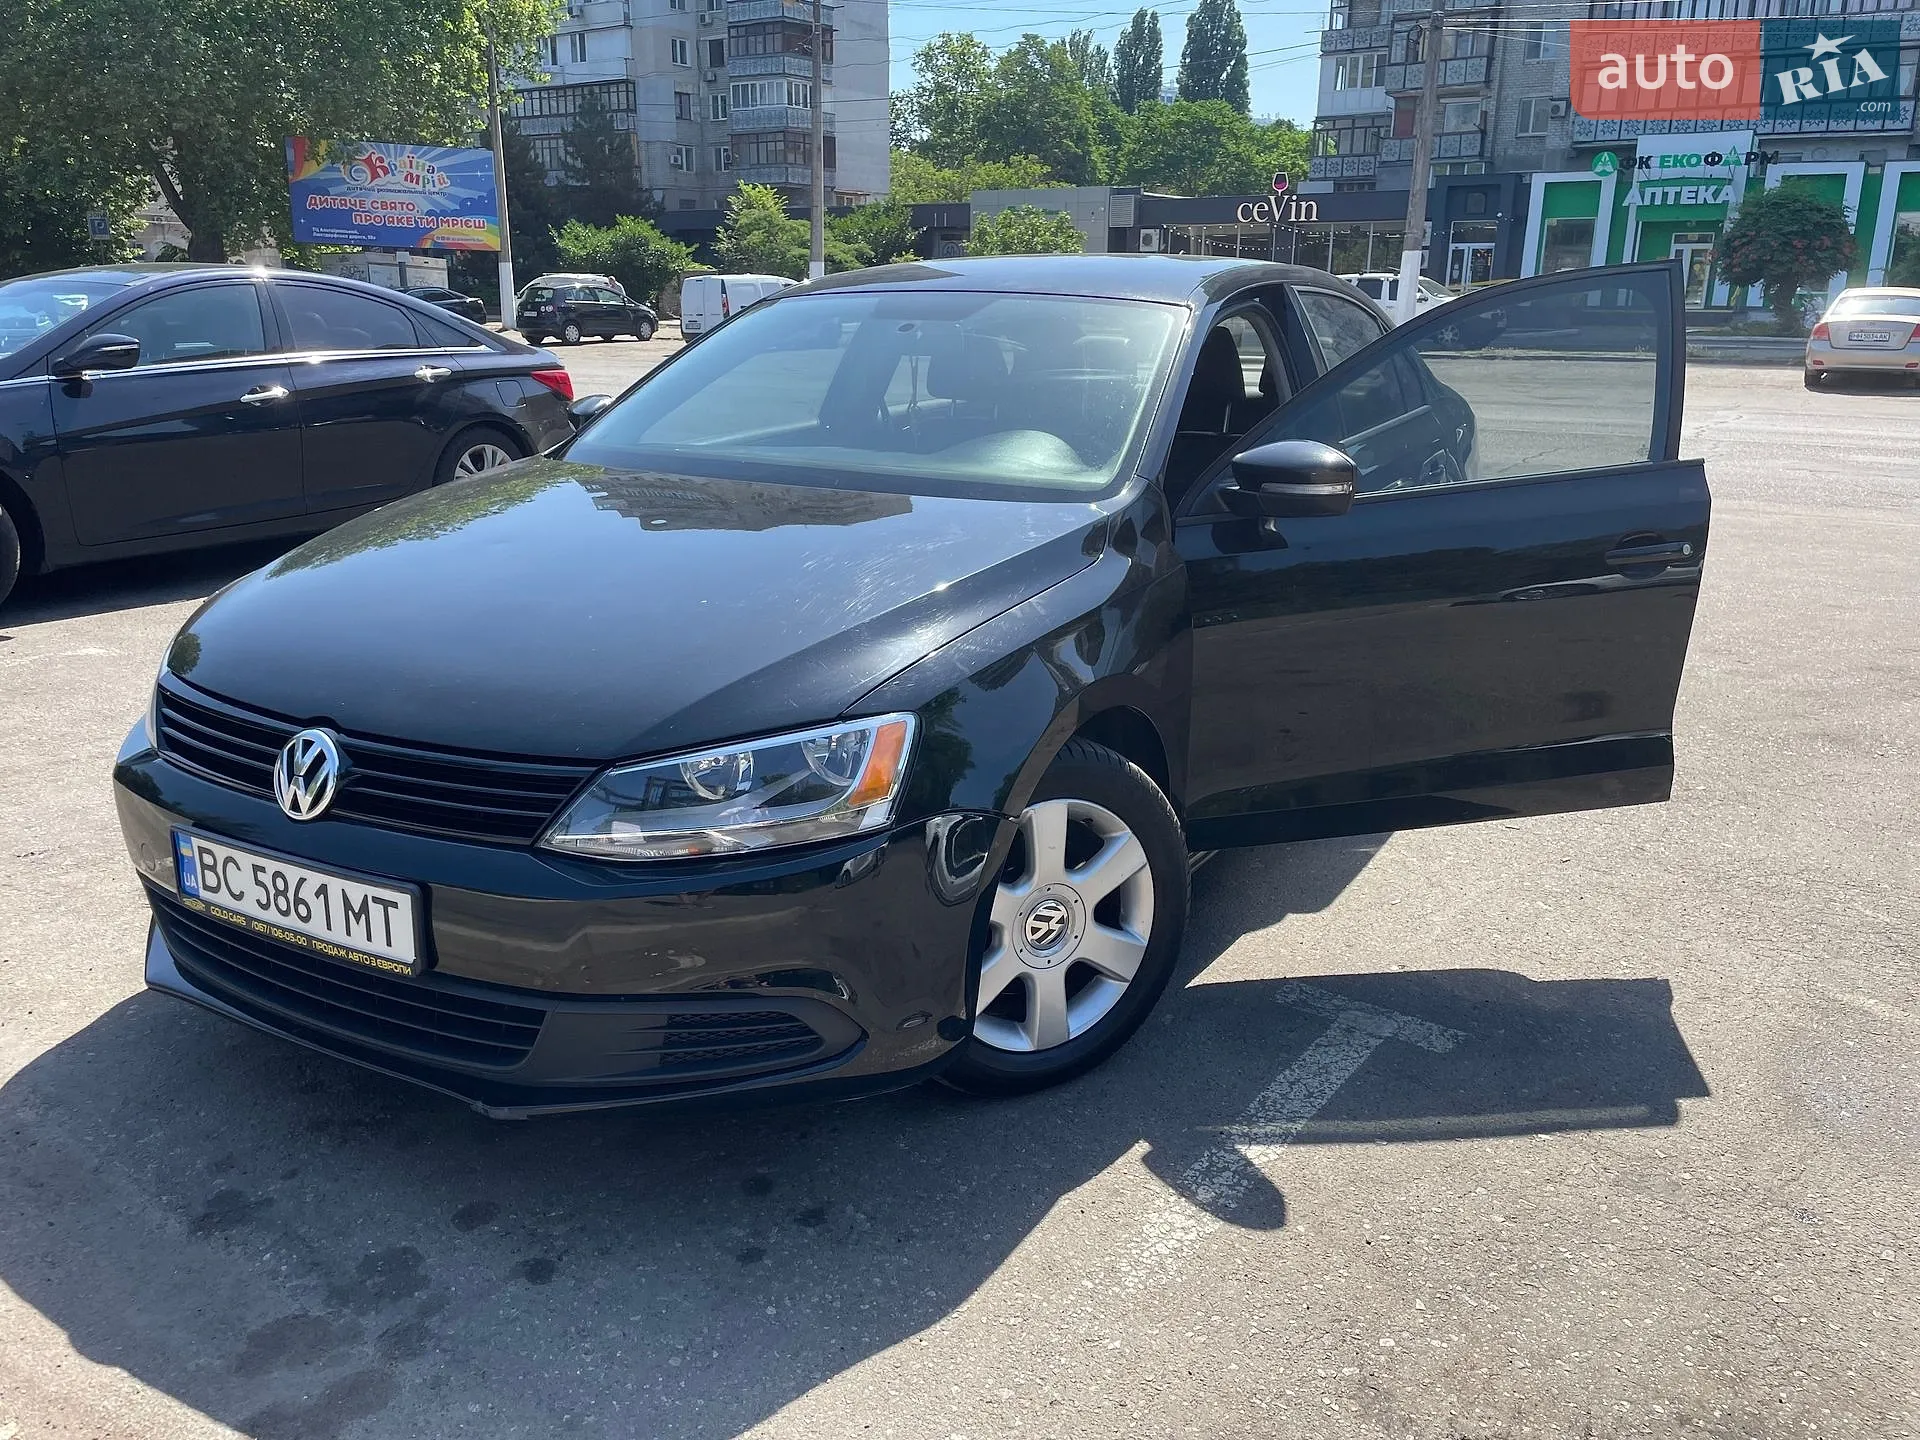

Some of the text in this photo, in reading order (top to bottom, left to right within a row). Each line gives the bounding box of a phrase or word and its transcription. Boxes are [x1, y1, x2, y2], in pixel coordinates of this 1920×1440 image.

[307, 196, 420, 214] ДИТЯЧЕ СВЯТО,
[1622, 185, 1738, 206] АПТЕКА
[1237, 195, 1319, 222] ceVin
[353, 213, 486, 230] ПРО ЯКЕ ТИ МРІЄШ
[183, 872, 198, 889] UA
[198, 846, 399, 948] BC 5861 MT
[210, 906, 228, 919] GOLD
[229, 912, 247, 926] CARS
[312, 940, 347, 959] ПРОДАЖ
[348, 951, 370, 965] АВТО
[377, 960, 412, 976] ЄВРОПИ
